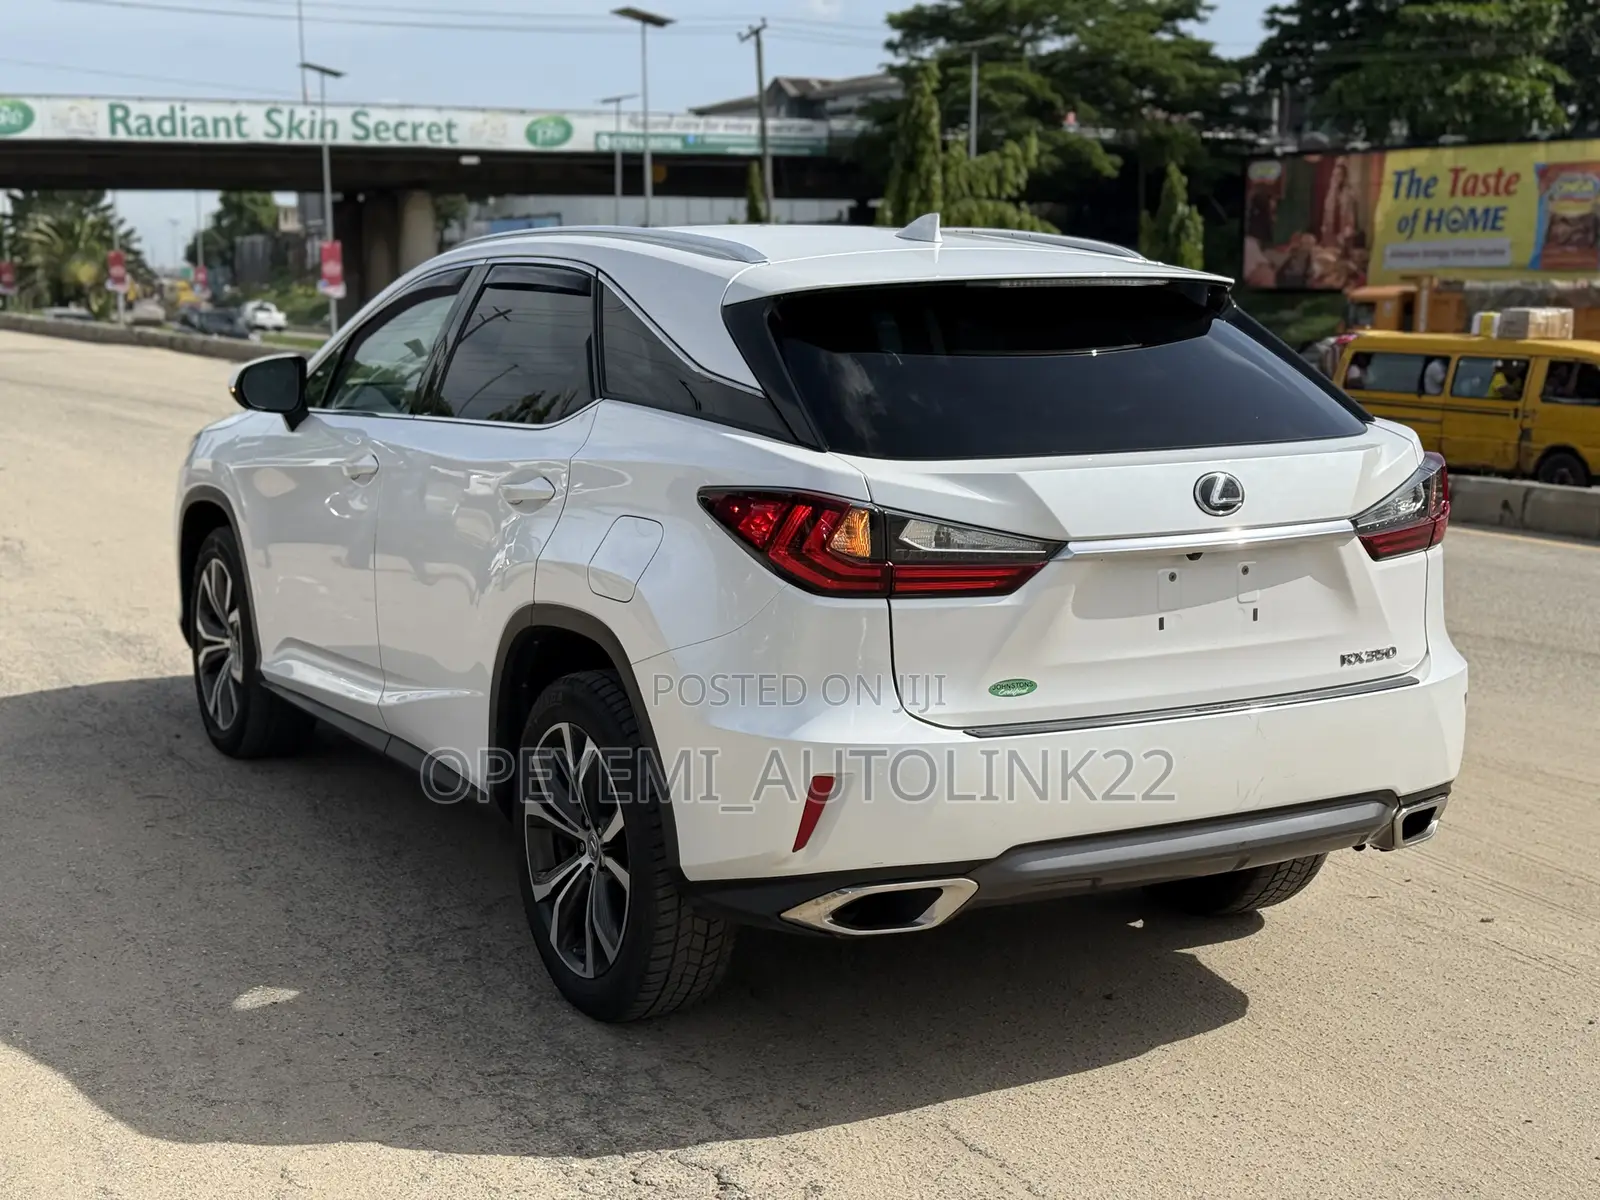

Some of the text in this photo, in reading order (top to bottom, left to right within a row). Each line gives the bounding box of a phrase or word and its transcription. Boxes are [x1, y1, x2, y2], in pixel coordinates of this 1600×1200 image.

[108, 103, 460, 144] Radiant Skin Secret
[1393, 167, 1522, 200] The Taste
[1397, 204, 1508, 240] of HOME
[1340, 646, 1397, 668] RX 350
